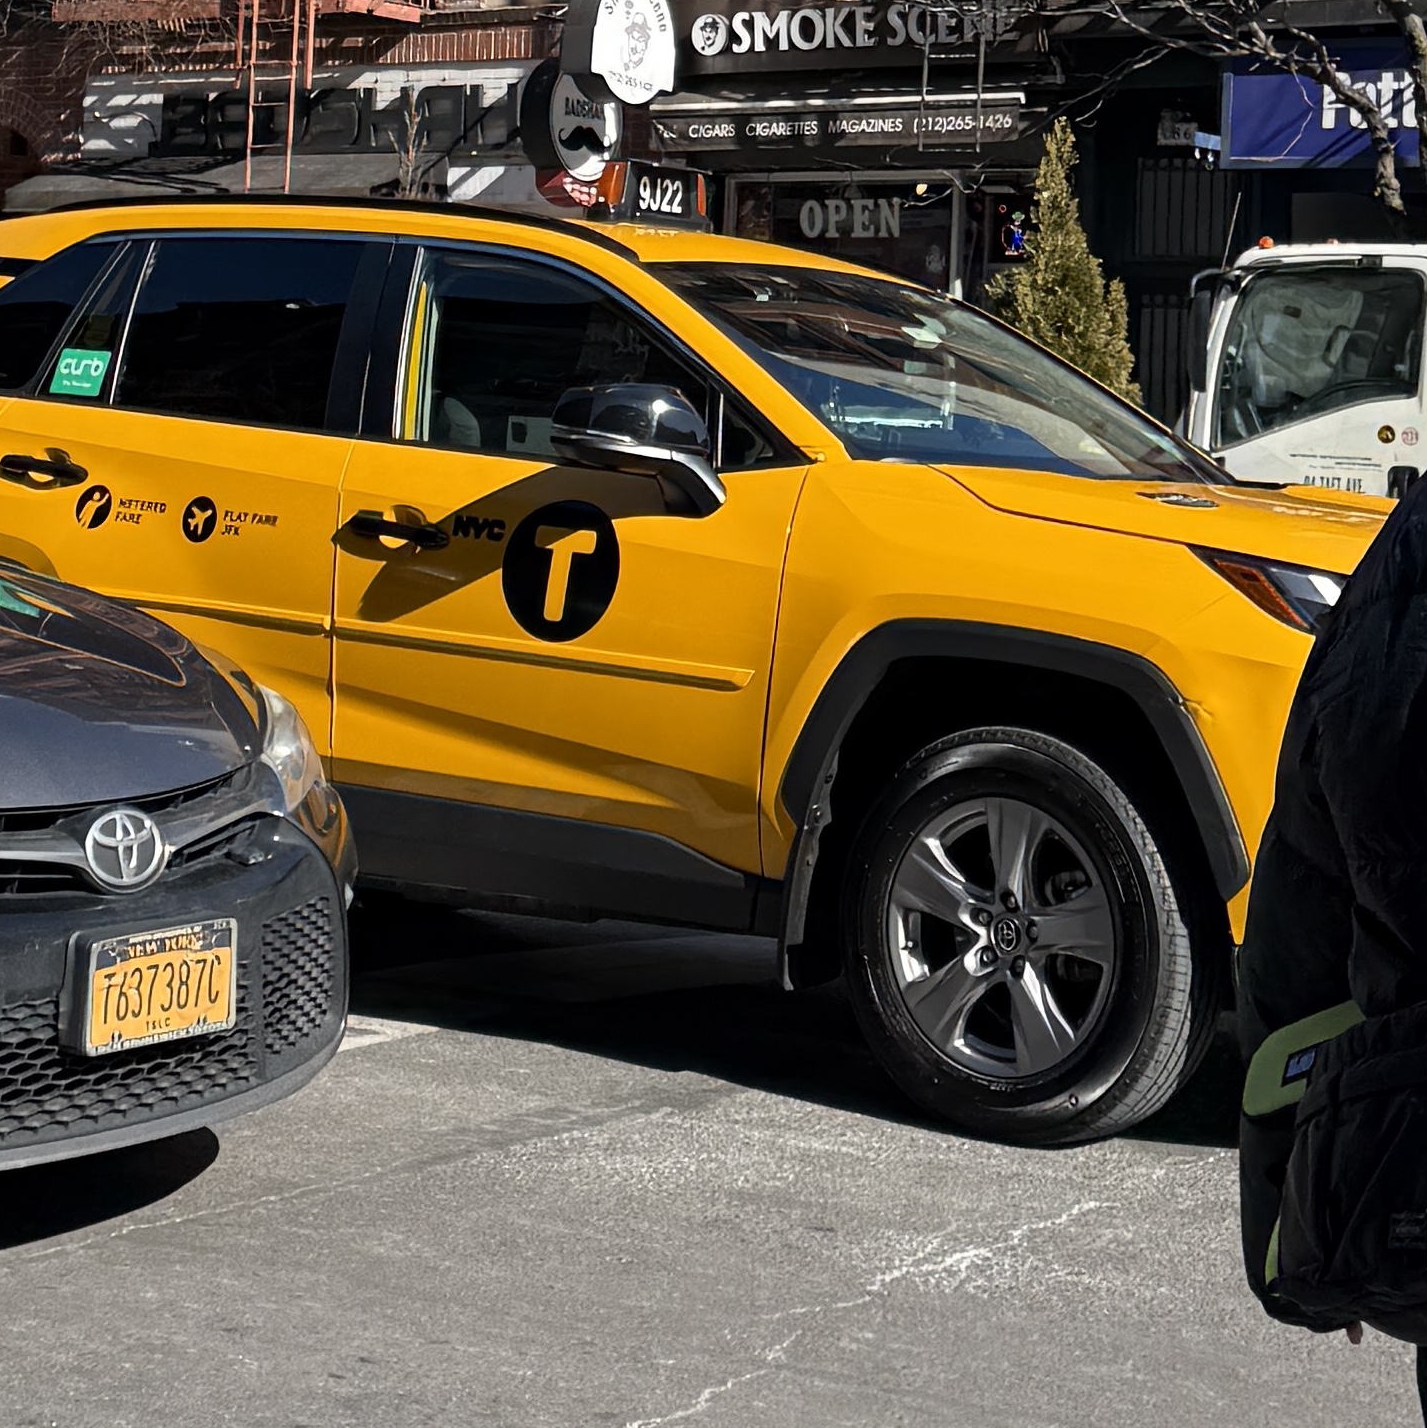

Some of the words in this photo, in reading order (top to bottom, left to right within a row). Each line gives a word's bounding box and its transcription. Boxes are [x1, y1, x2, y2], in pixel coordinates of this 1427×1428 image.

[731, 6, 879, 54] SMOKE
[689, 124, 736, 139] CIGARS
[745, 121, 818, 137] CIGARETTES
[828, 118, 903, 134] MAGAZINES
[639, 176, 683, 214] 9J22
[799, 198, 901, 239] OPEN
[60, 357, 104, 377] curb
[452, 515, 506, 542] NYC
[534, 525, 597, 622] T
[103, 954, 222, 1025] T637387C
